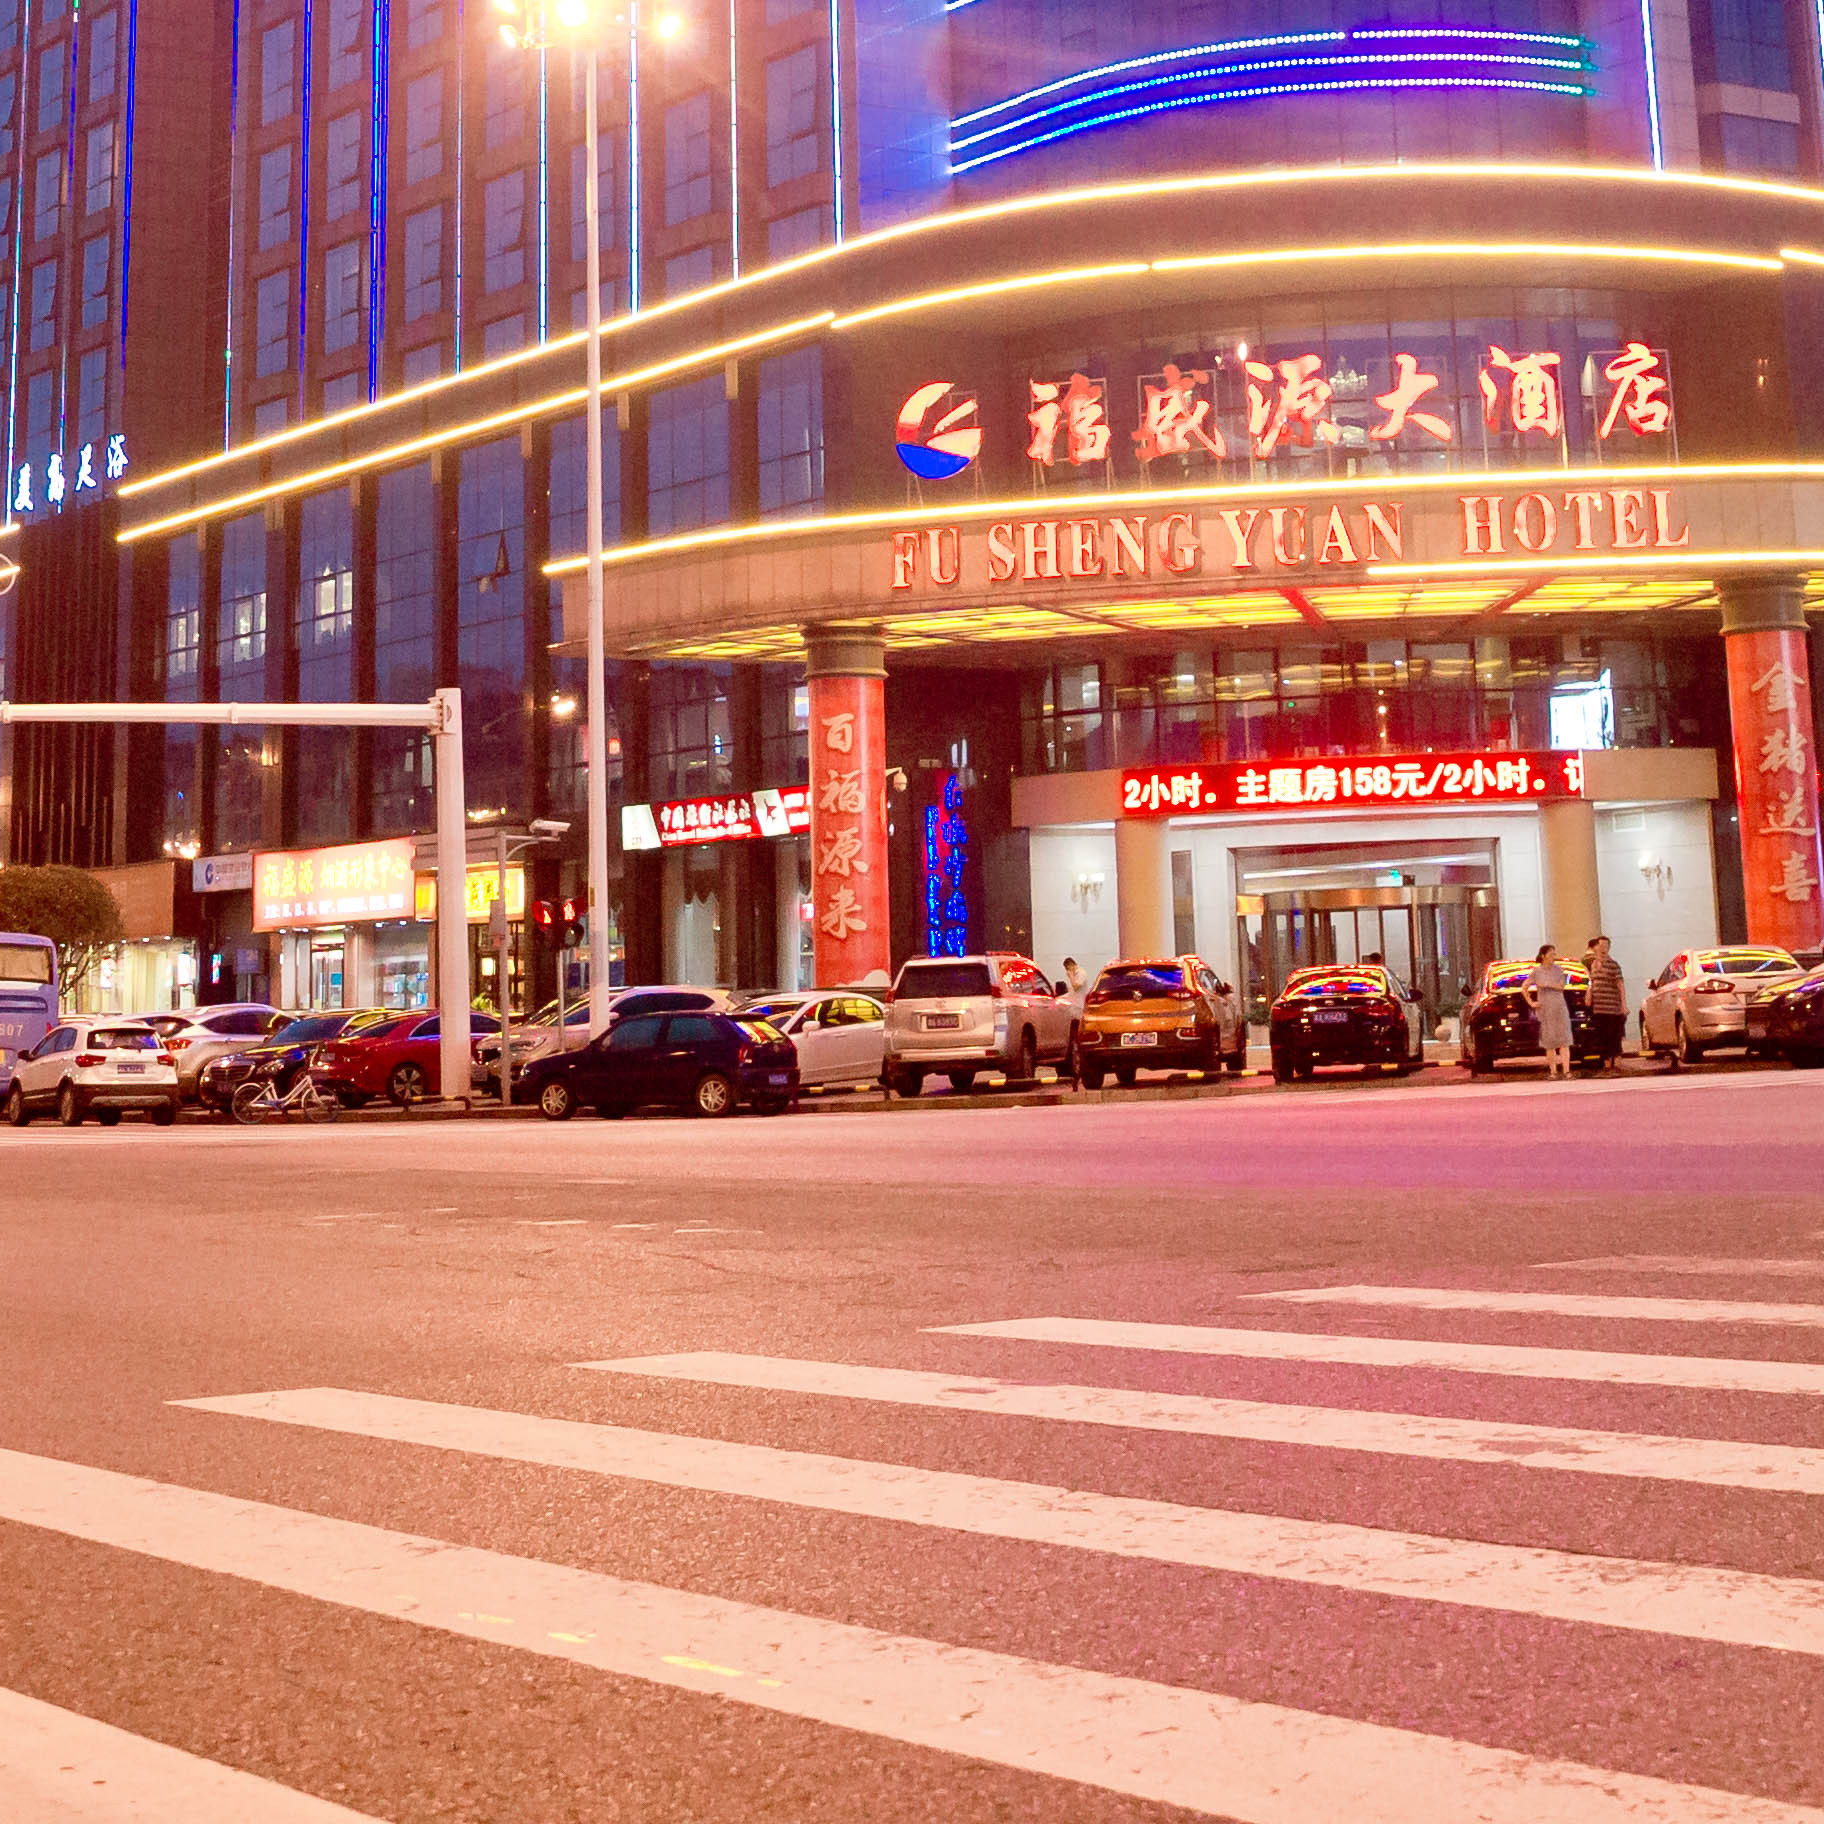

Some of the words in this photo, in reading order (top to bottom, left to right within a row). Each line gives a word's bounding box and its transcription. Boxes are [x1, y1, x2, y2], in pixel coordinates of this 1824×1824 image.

[1025, 341, 1672, 468] 福盛源大酒店
[891, 526, 963, 590] FU
[987, 509, 1201, 583] SHENG
[1216, 500, 1405, 570] YUAN
[1460, 488, 1691, 556] HOTEL
[818, 713, 868, 941] 百福源来
[1751, 661, 1819, 903] 金猪送喜
